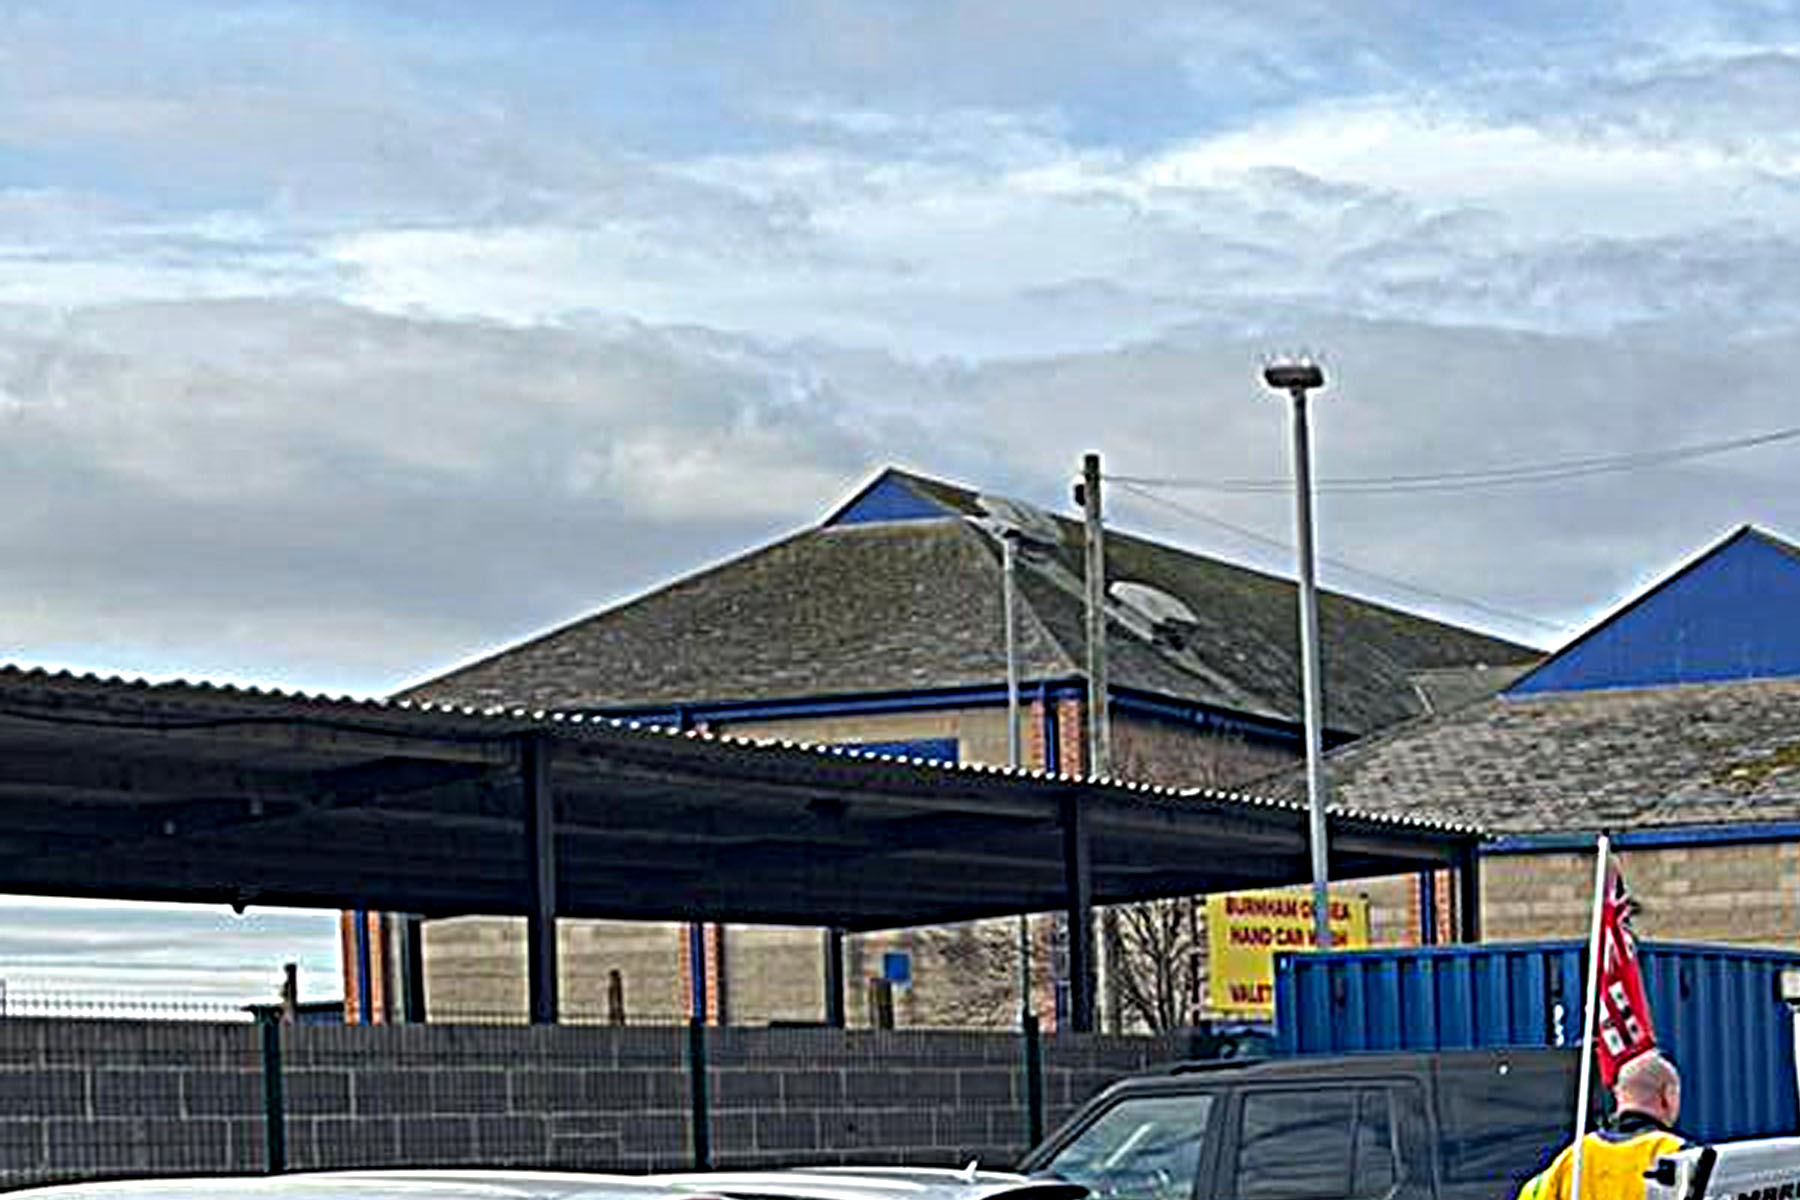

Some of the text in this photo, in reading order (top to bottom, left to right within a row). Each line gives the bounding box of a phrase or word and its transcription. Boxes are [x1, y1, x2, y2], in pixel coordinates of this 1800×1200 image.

[1226, 897, 1299, 918] BURNHAM
[1230, 927, 1272, 946] HAND
[1276, 927, 1304, 946] CAR
